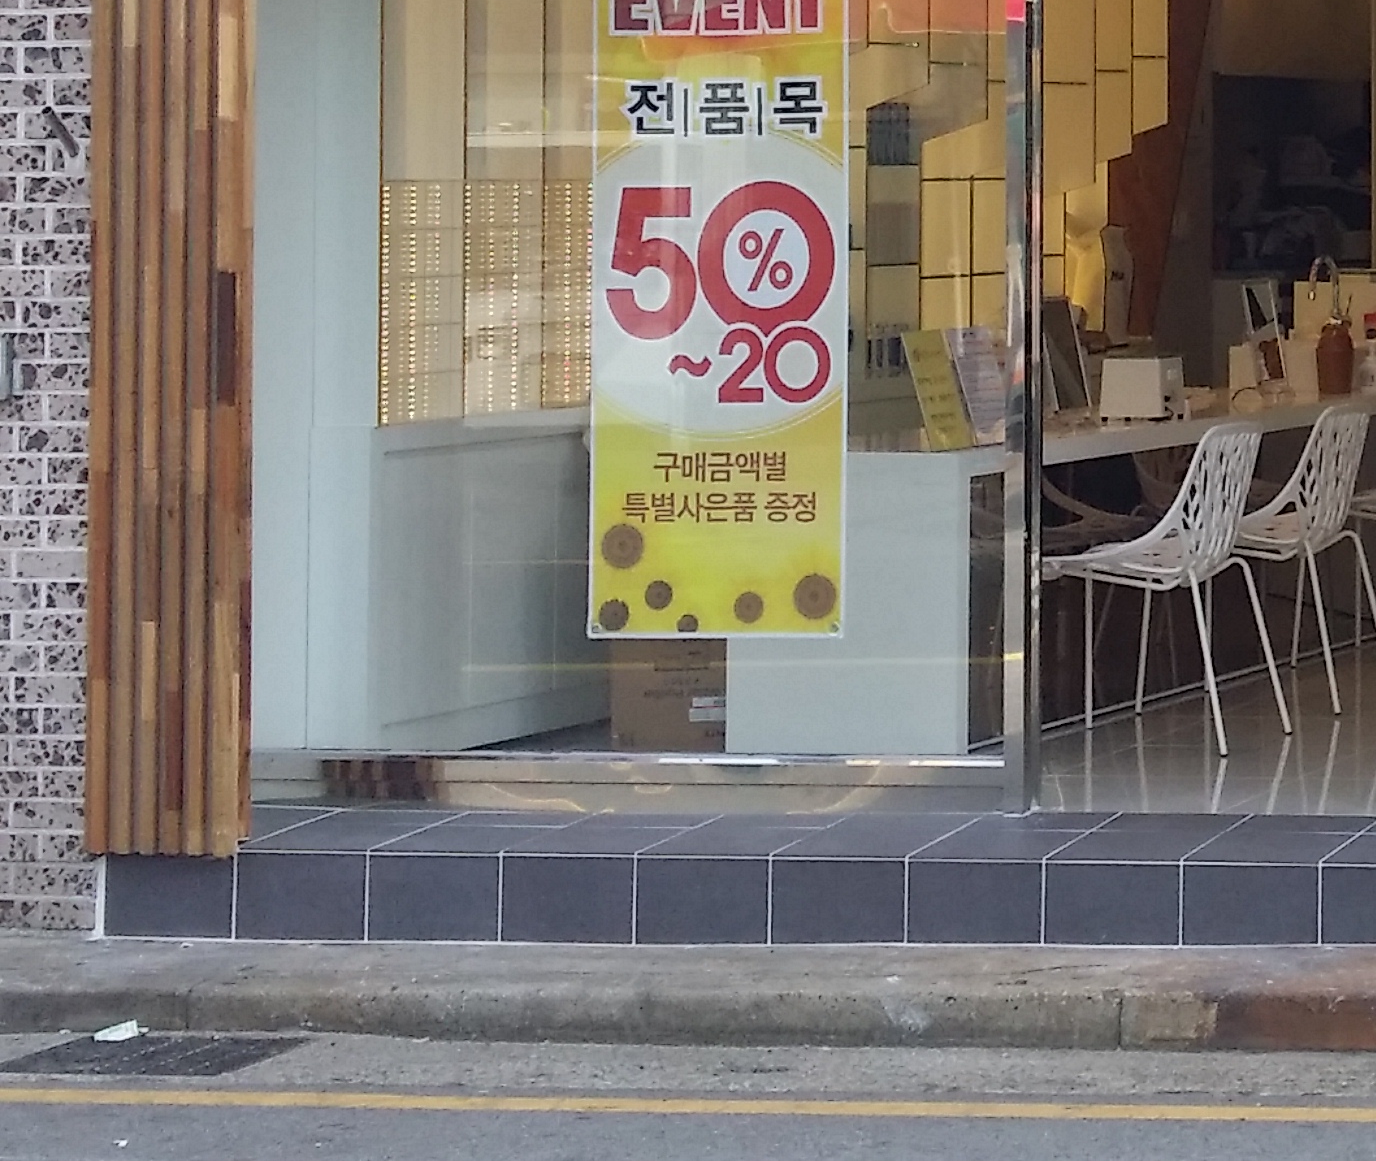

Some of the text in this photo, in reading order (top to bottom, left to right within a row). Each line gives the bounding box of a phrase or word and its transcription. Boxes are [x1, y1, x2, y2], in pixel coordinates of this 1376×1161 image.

[606, 180, 836, 340] 50%
[668, 327, 831, 404] ~20
[653, 450, 788, 482] 구매금액별
[621, 491, 818, 524] 특별사은품 증정
